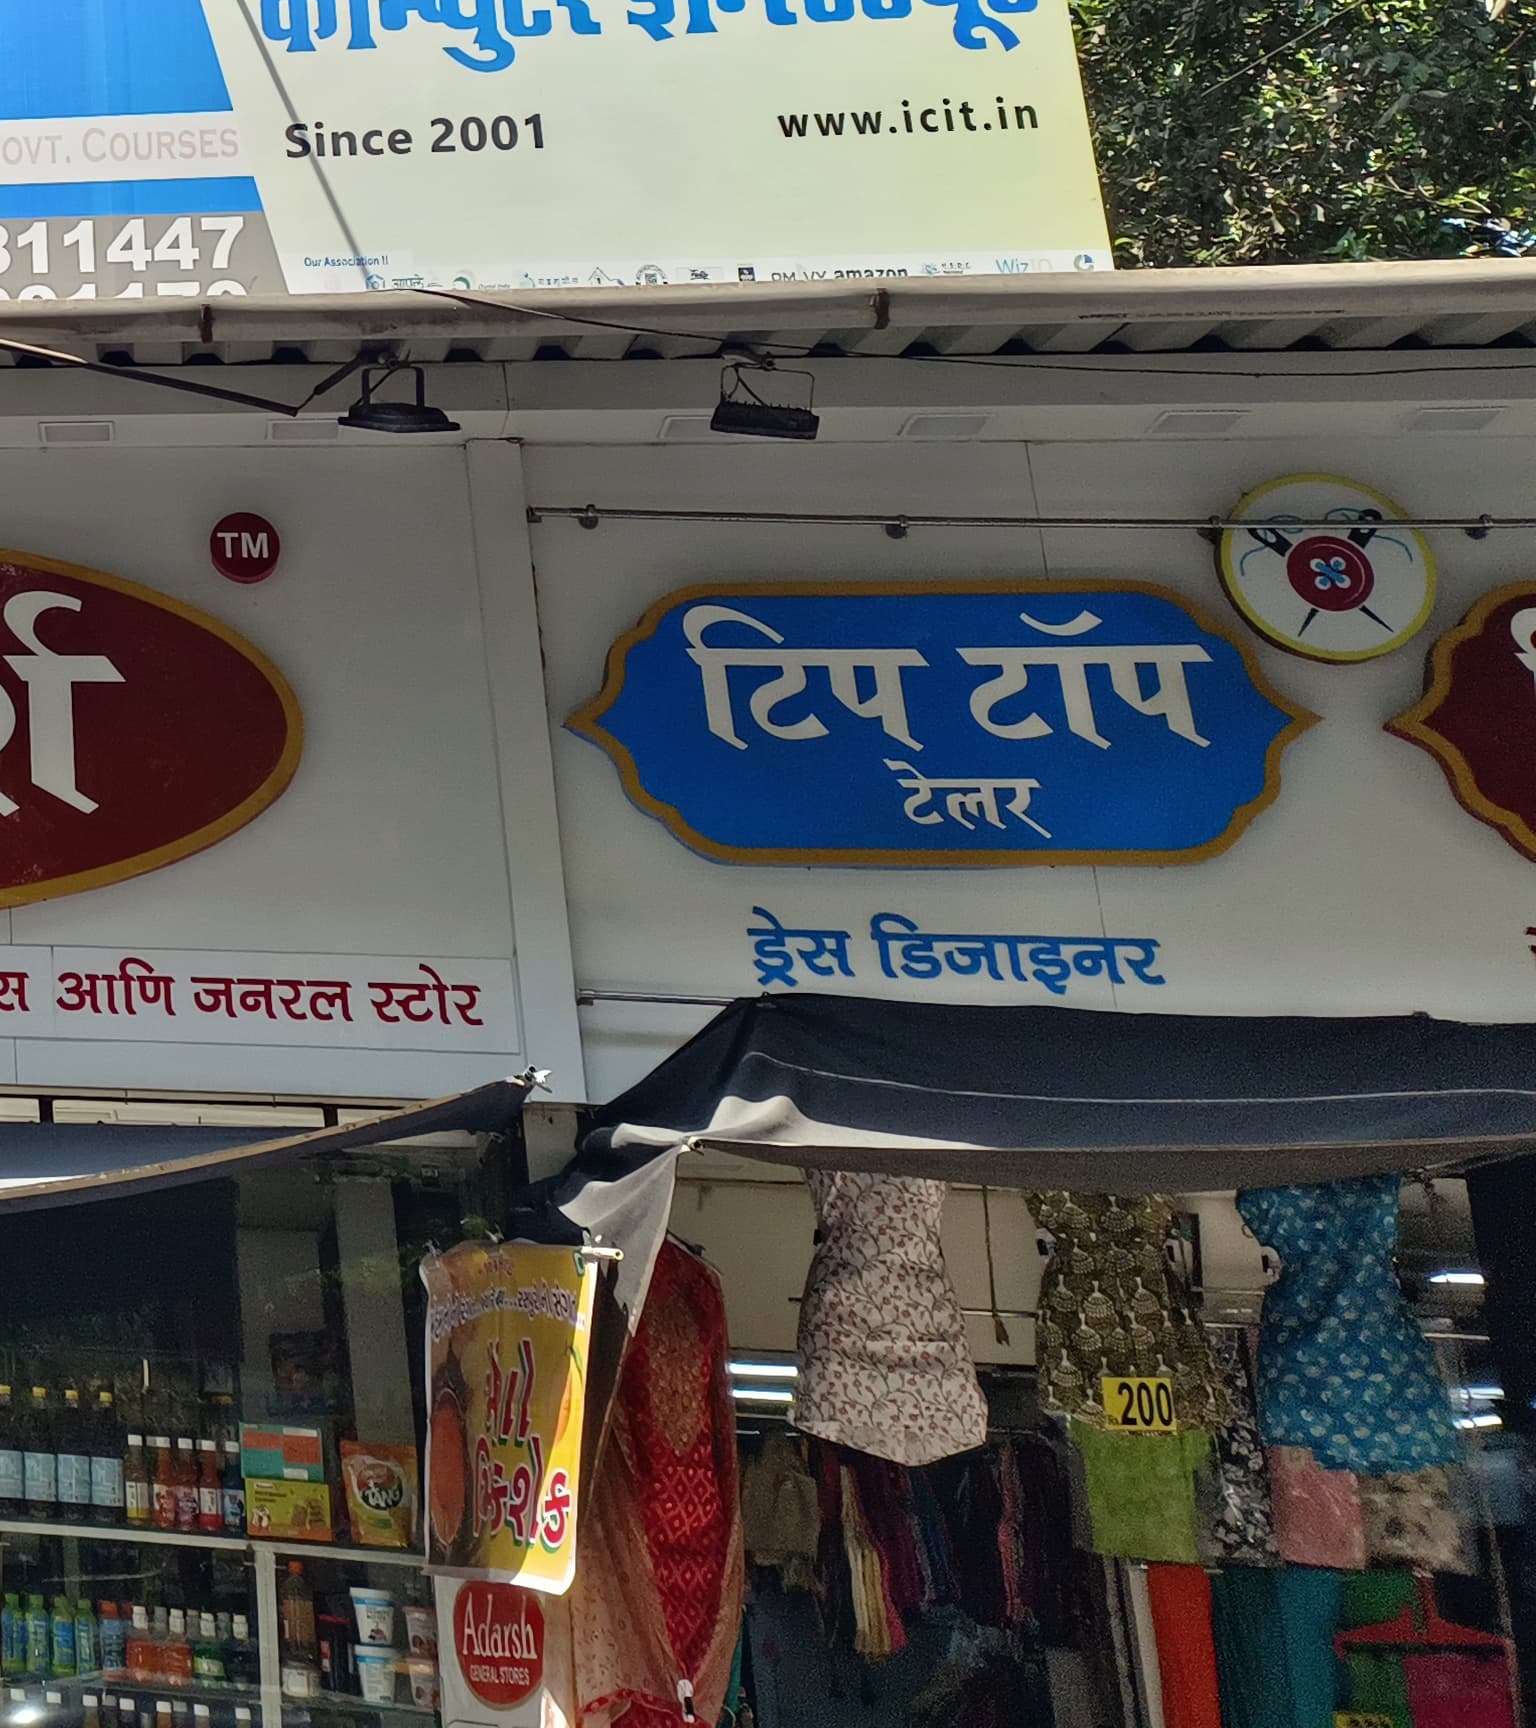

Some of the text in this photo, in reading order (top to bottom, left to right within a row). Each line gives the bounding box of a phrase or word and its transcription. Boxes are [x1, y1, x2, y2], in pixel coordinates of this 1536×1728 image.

[285, 113, 545, 158] Since 2001
[777, 96, 1039, 138] www.icit.in
[304, 255, 379, 267] Our Association
[216, 532, 270, 559] TM
[683, 603, 1212, 752] टिप टॉप
[882, 757, 1052, 840] टेलर
[746, 906, 1165, 995] ड्रेस डिजाइनर
[56, 958, 175, 1016] आणि
[191, 974, 354, 1022] जनरल
[368, 964, 484, 1026] स्टोर
[1118, 1382, 1173, 1426] 200
[463, 1592, 538, 1660] Adarsh
[470, 1665, 529, 1685] GENERAL STORES
